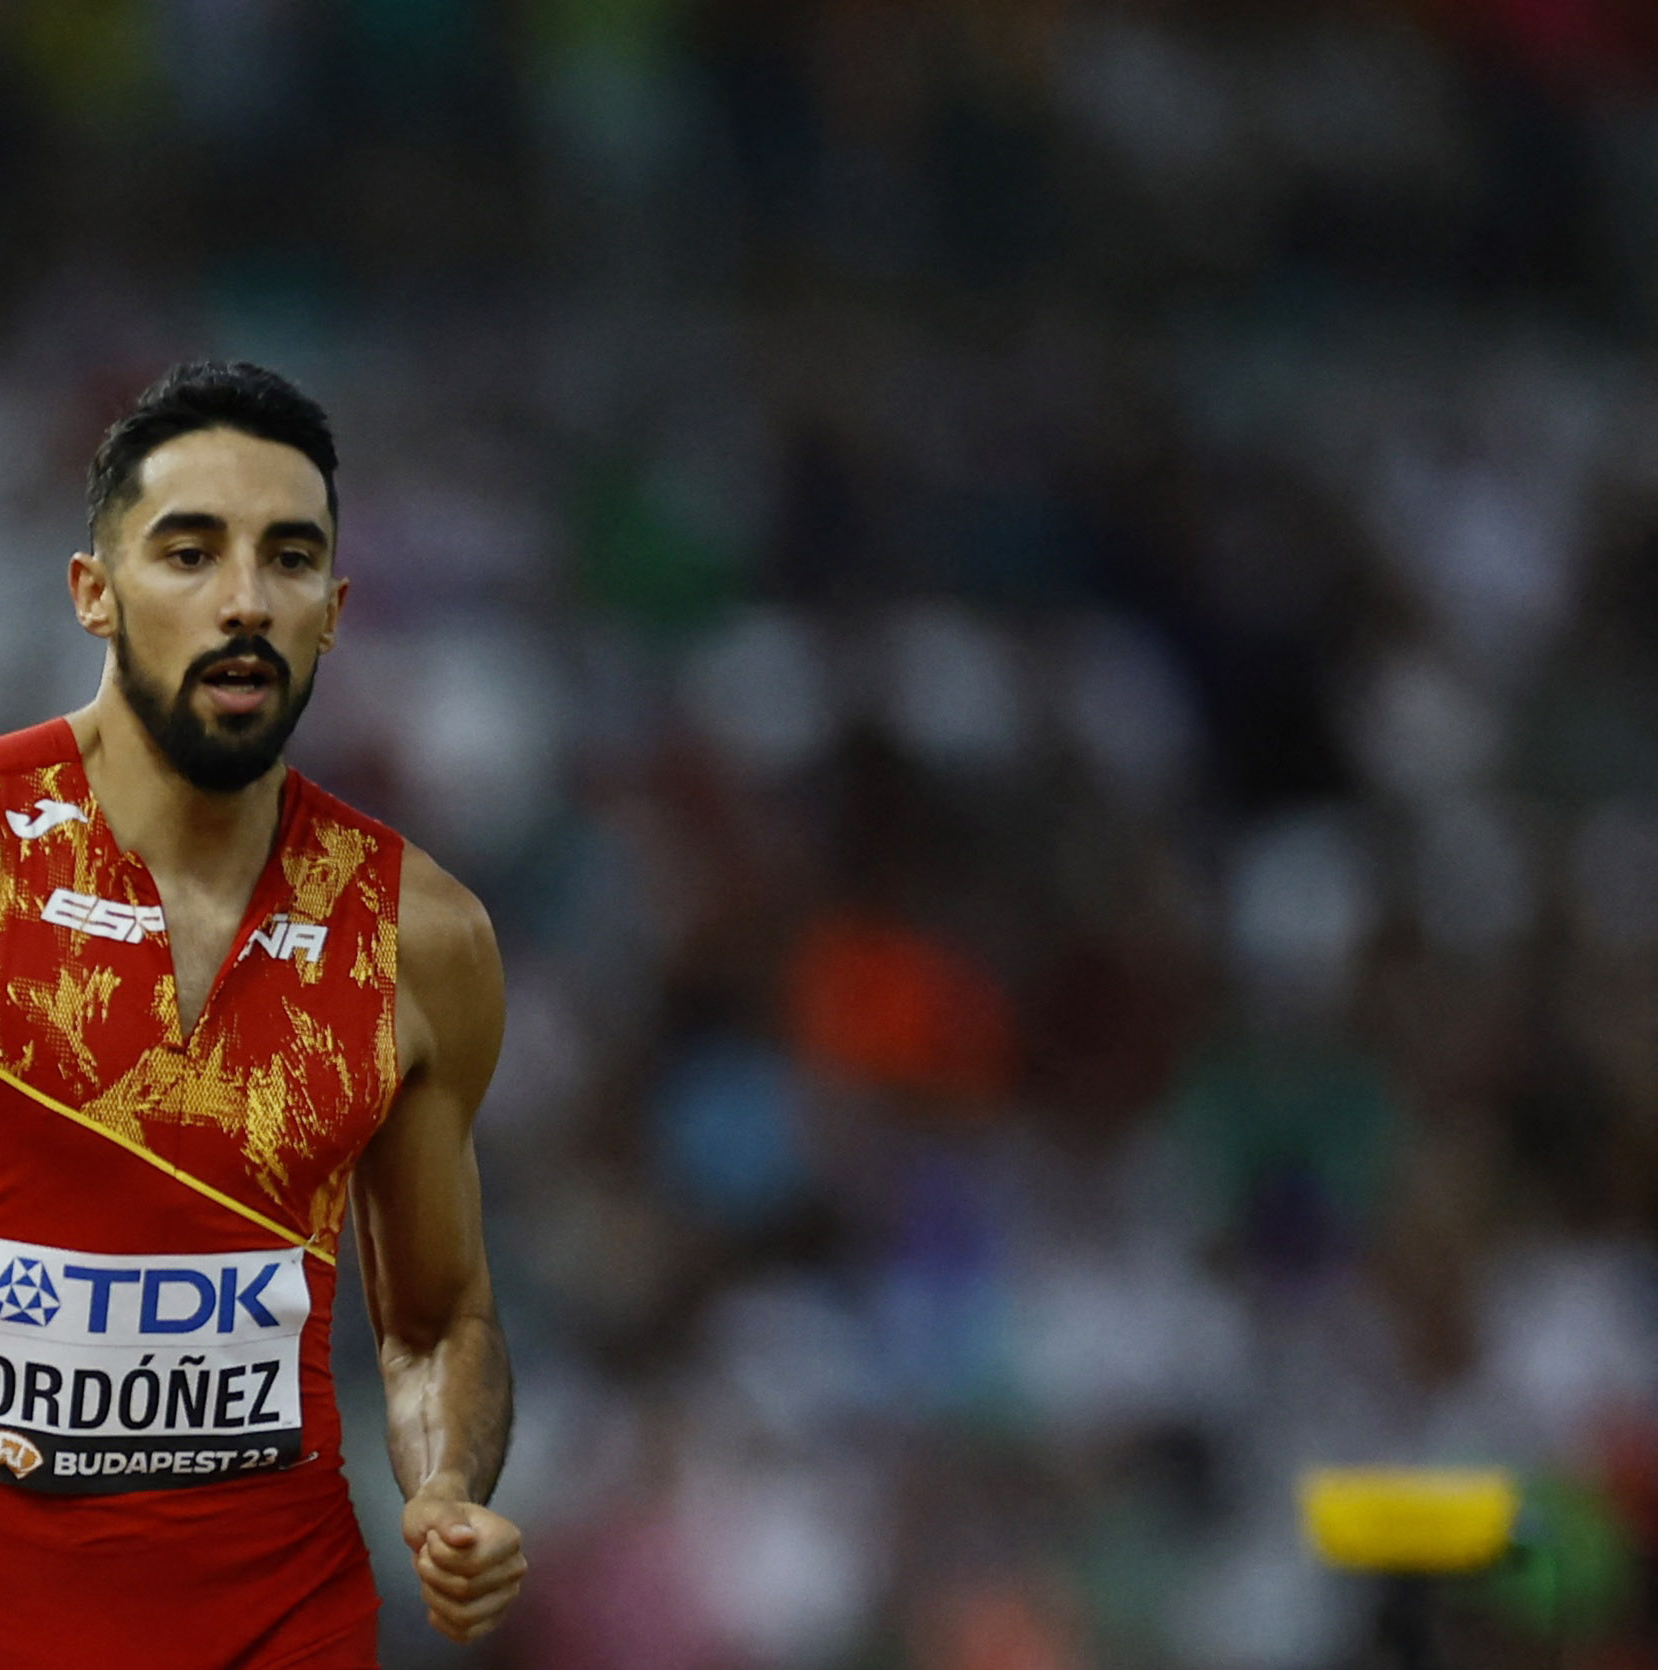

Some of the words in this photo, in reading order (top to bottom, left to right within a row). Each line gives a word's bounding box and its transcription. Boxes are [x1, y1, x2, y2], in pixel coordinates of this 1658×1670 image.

[63, 1263, 281, 1335] TDK
[53, 1448, 237, 1478] BUDAPEST
[240, 1447, 278, 1471] 23
